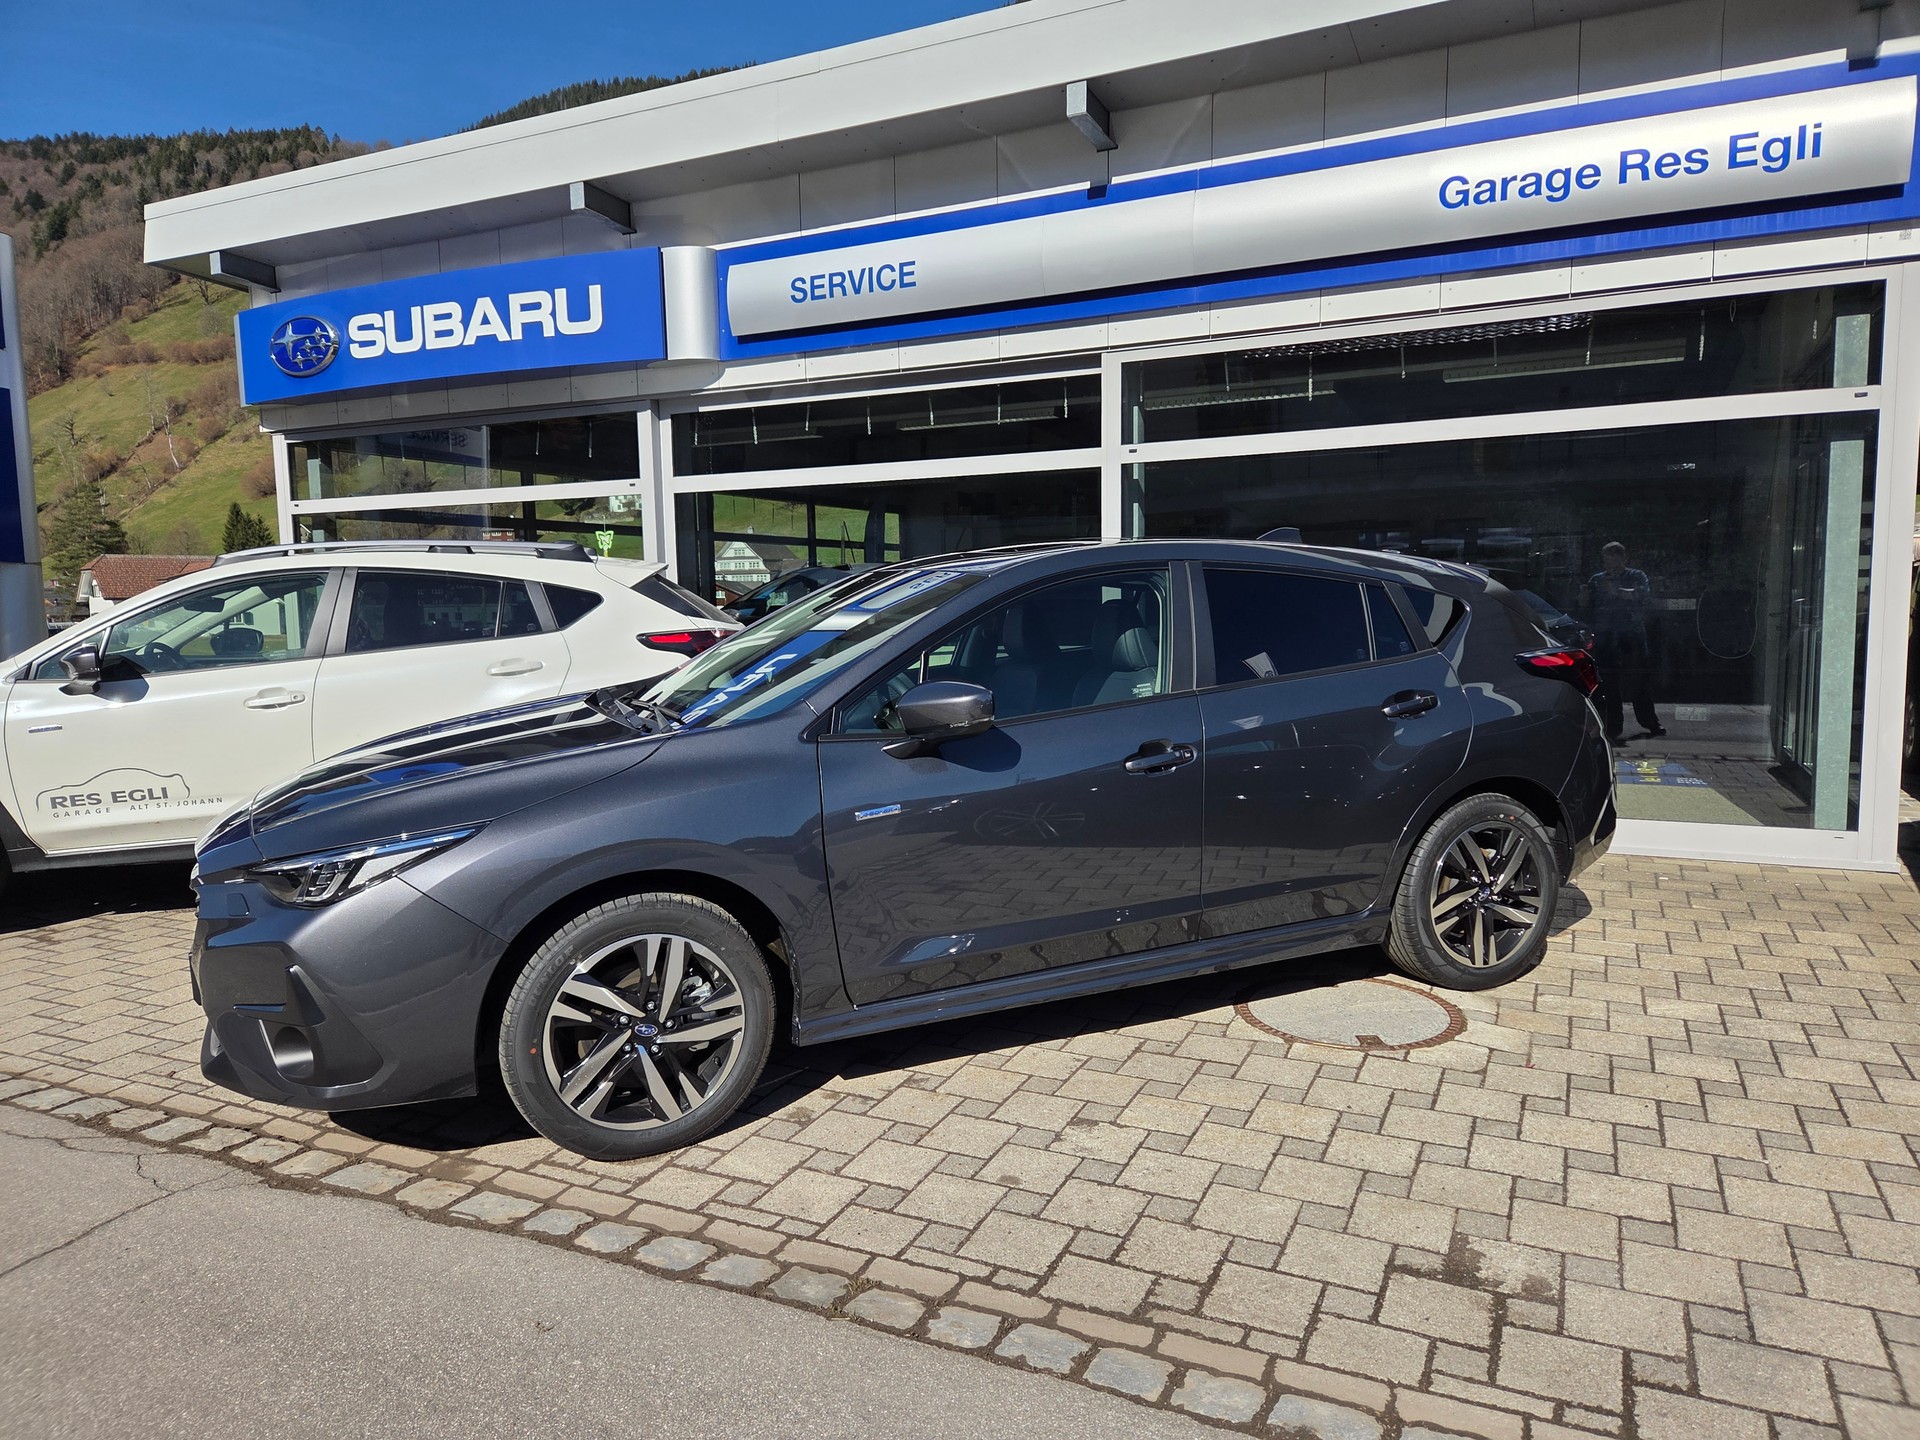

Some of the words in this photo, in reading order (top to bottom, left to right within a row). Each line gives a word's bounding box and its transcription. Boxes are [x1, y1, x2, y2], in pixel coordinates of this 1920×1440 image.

[1438, 163, 1602, 210] Garage
[1618, 148, 1710, 185] Res
[1727, 121, 1823, 174] Egli
[790, 260, 917, 304] SERVICE
[348, 284, 603, 360] SUBARU
[50, 792, 102, 810] RES
[111, 786, 169, 804] EGLI
[52, 807, 111, 819] GARAGE
[129, 803, 150, 811] ALT
[156, 801, 172, 809] ST.
[176, 797, 223, 807] JOHANN
